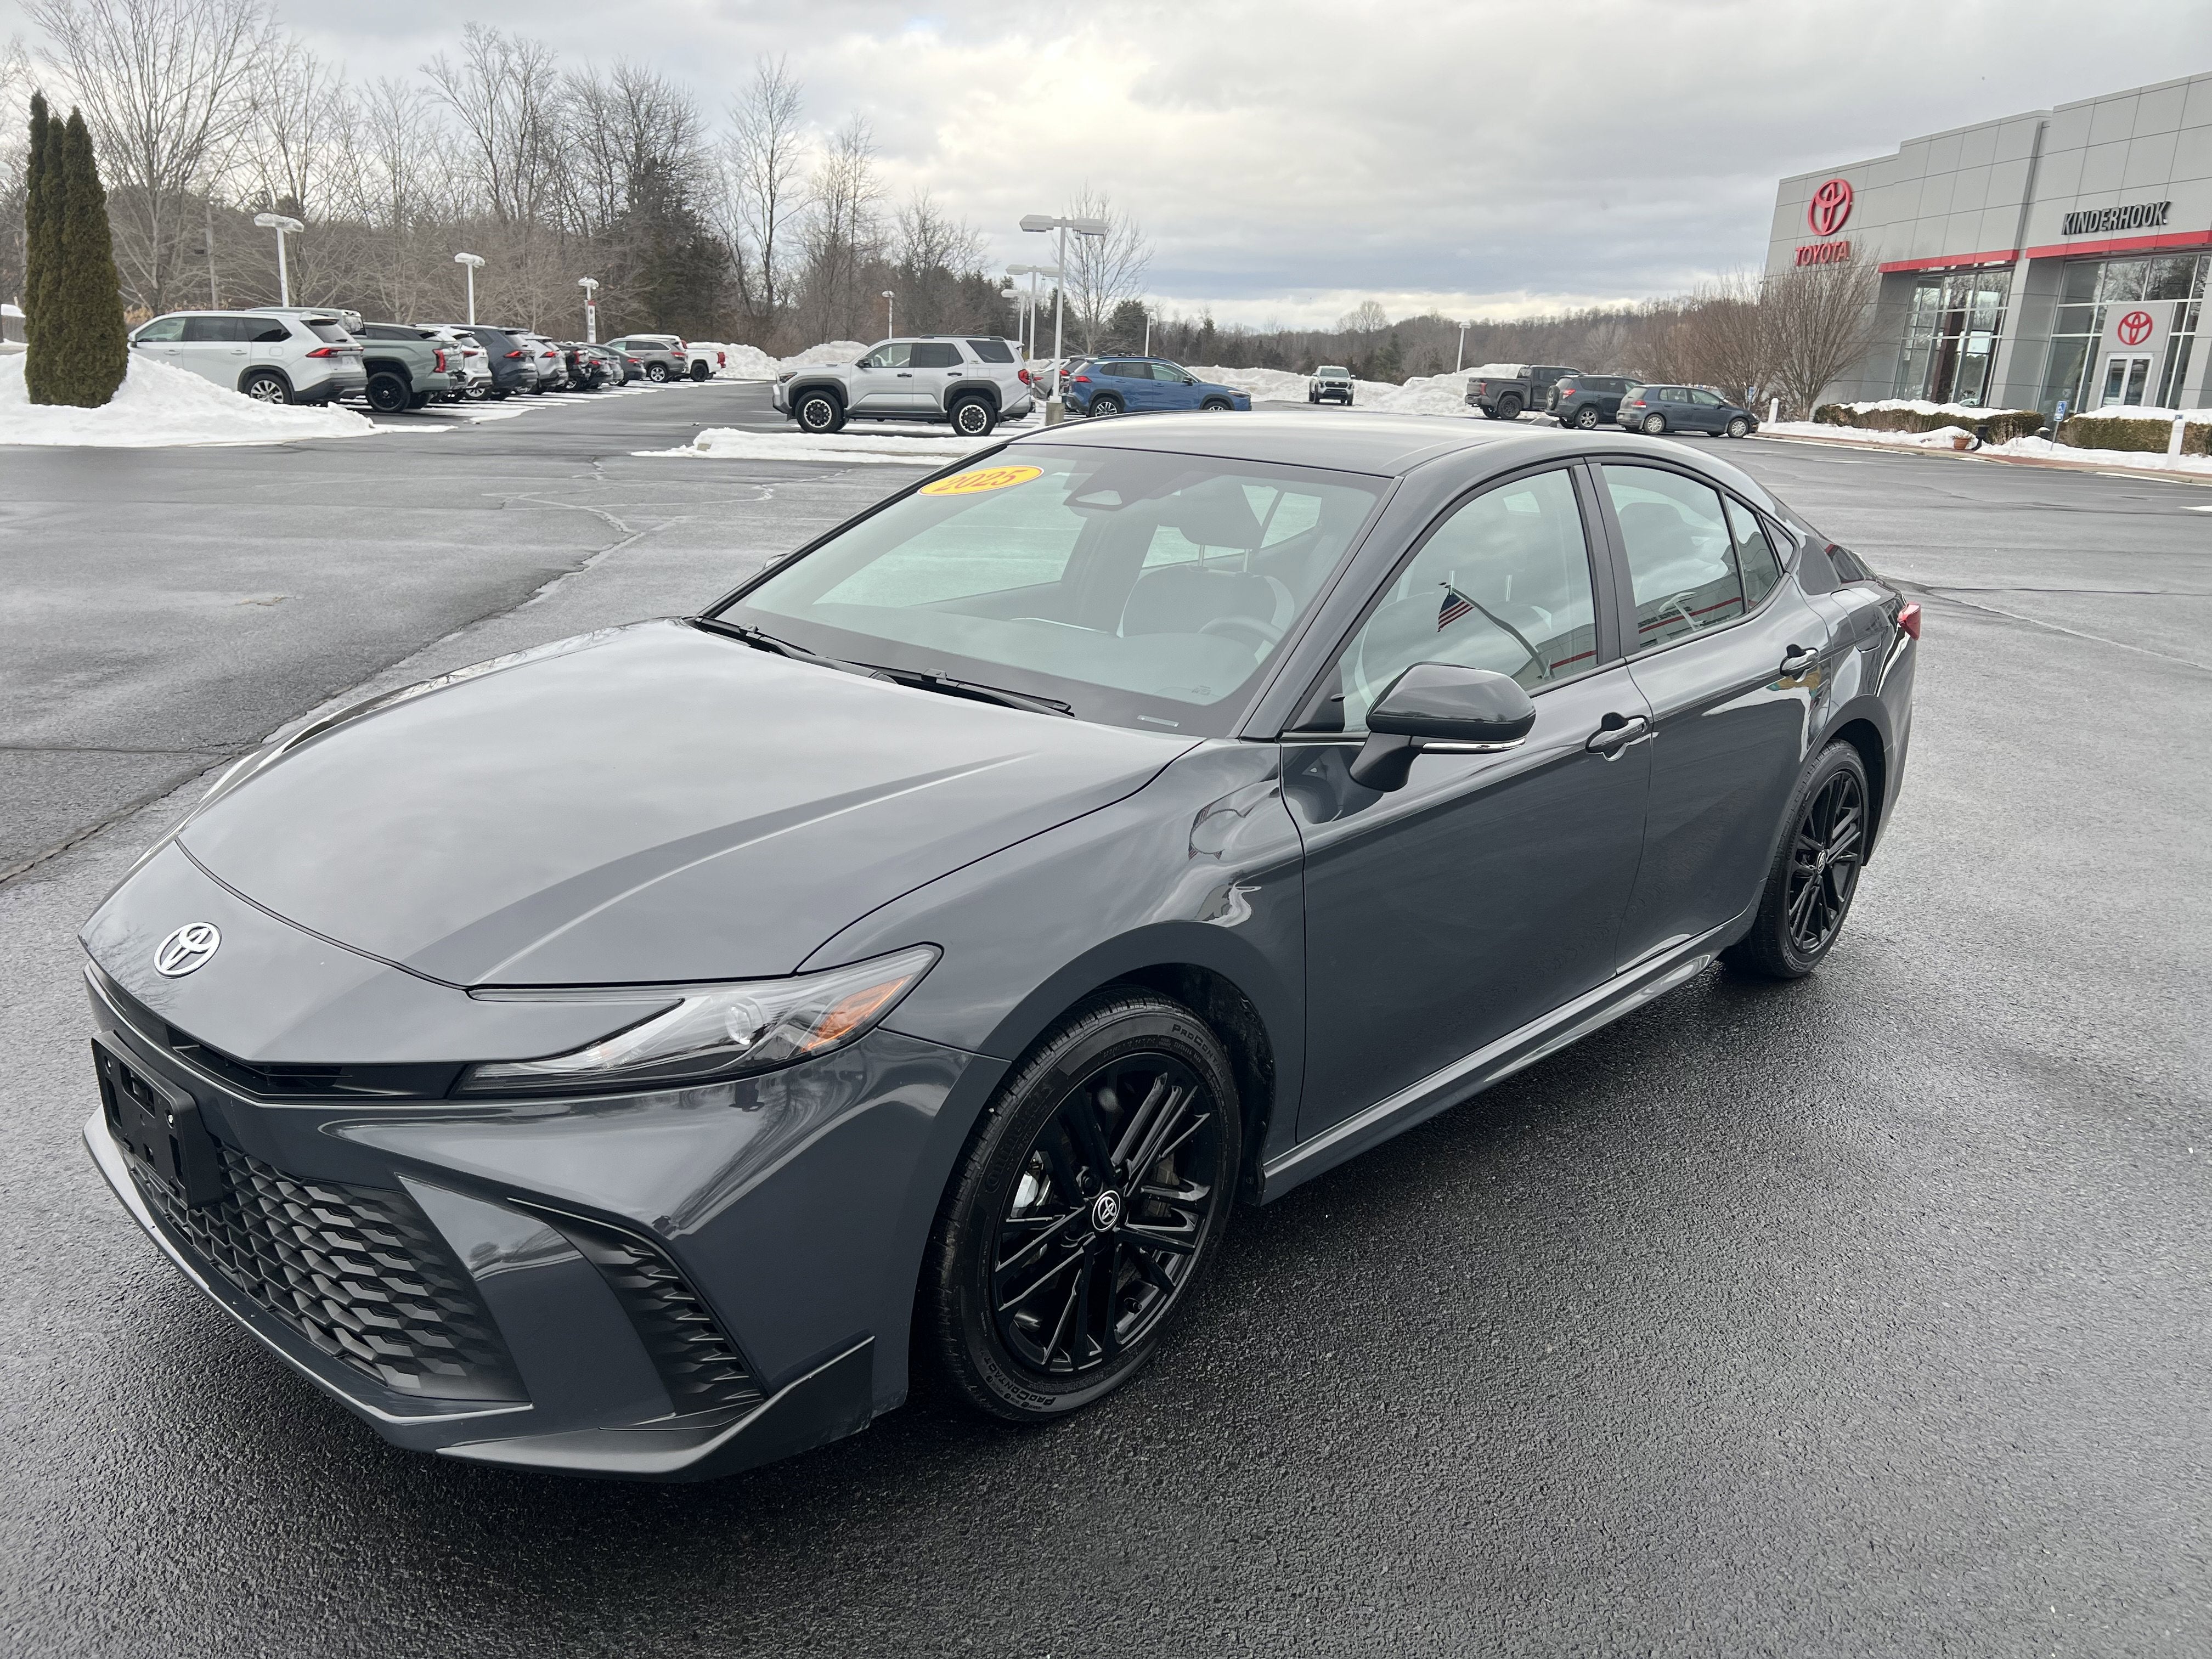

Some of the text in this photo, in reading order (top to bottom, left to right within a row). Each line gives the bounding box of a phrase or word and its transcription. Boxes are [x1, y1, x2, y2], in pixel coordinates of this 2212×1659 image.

[2061, 201, 2171, 235] KINDERHOOK
[1795, 240, 1850, 267] TOYOTA
[933, 469, 1030, 492] 2025
